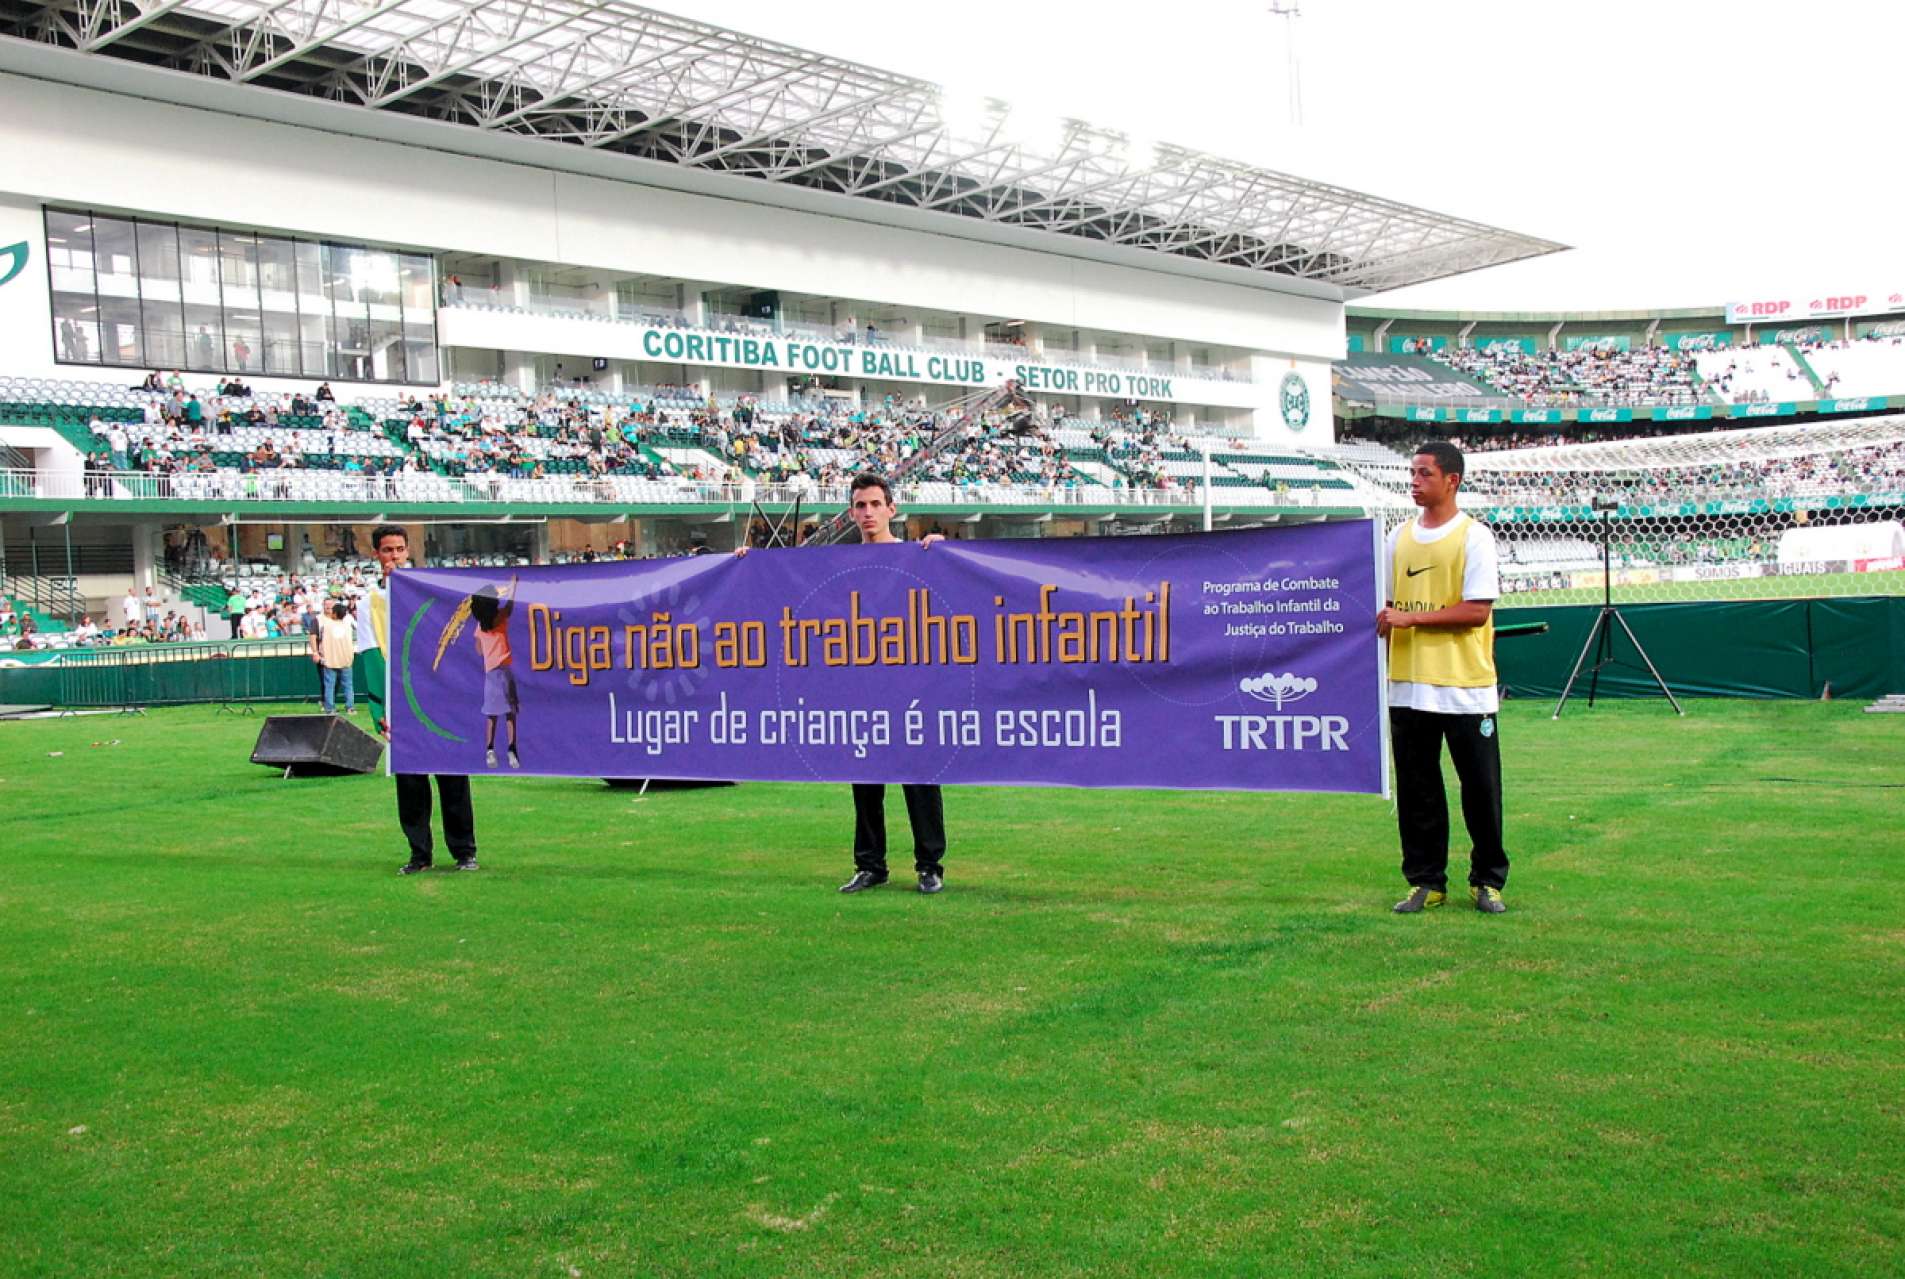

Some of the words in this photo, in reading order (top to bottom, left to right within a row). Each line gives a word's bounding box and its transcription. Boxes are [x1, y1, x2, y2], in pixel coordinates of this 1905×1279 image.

[1751, 301, 1791, 315] RDP
[1826, 295, 1867, 310] RDP
[643, 330, 779, 366] CORITIBA
[787, 342, 853, 372] FOOT
[862, 351, 920, 378] BALL
[927, 356, 985, 383] CLUB
[1016, 364, 1078, 391] SETOR
[1085, 371, 1120, 393] PRO
[1126, 375, 1173, 398] TORK
[1695, 566, 1740, 579] SOMOS
[1203, 581, 1261, 596] Programa
[1263, 578, 1279, 591] de
[1281, 576, 1339, 591] Combate
[1204, 604, 1219, 615] ao
[1220, 600, 1274, 614] Trabalho
[1277, 599, 1321, 613] Infantil
[1323, 597, 1340, 611] da
[528, 603, 612, 686] Diga
[624, 611, 699, 670] não
[715, 620, 768, 668] ao
[779, 588, 978, 667] trabalho
[994, 581, 1171, 664] infantil
[1225, 623, 1266, 637] Justiça
[1268, 621, 1286, 634] do
[1287, 620, 1344, 634] Trabalho
[609, 691, 699, 755] Lugar
[710, 691, 748, 745] de
[759, 698, 890, 758] criança
[905, 699, 924, 746] é
[938, 710, 981, 746] na
[996, 688, 1121, 747] escola
[1214, 715, 1350, 750] TRTPR
